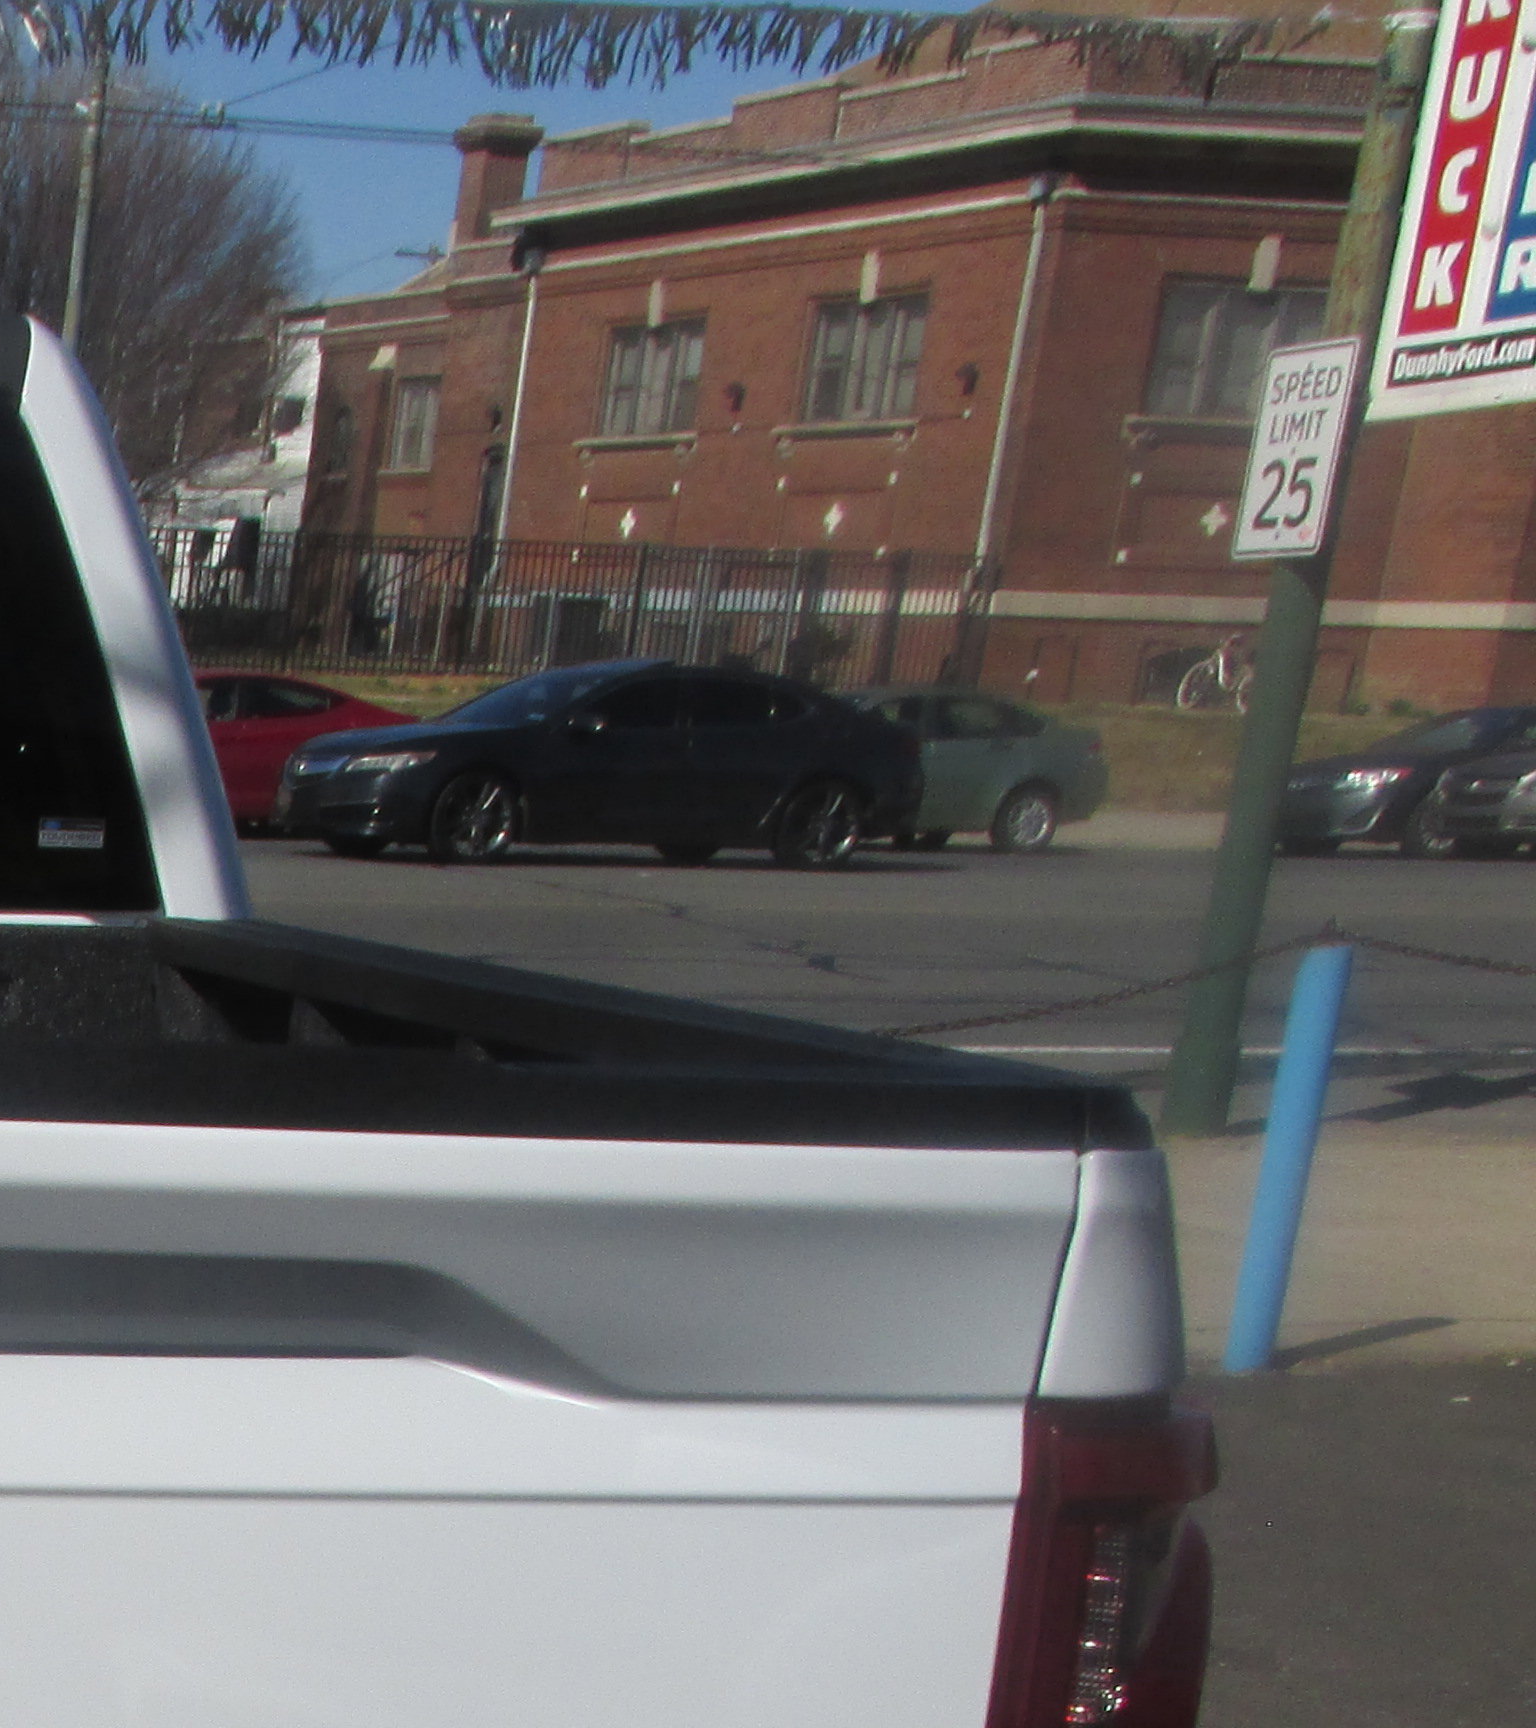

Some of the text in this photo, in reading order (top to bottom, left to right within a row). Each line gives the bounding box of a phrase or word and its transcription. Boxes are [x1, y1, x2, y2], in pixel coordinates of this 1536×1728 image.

[1392, 338, 1536, 380] DunphyFord.com
[1271, 365, 1342, 404] SPEED
[1269, 408, 1328, 444] LIMIT
[1252, 456, 1318, 529] 25
